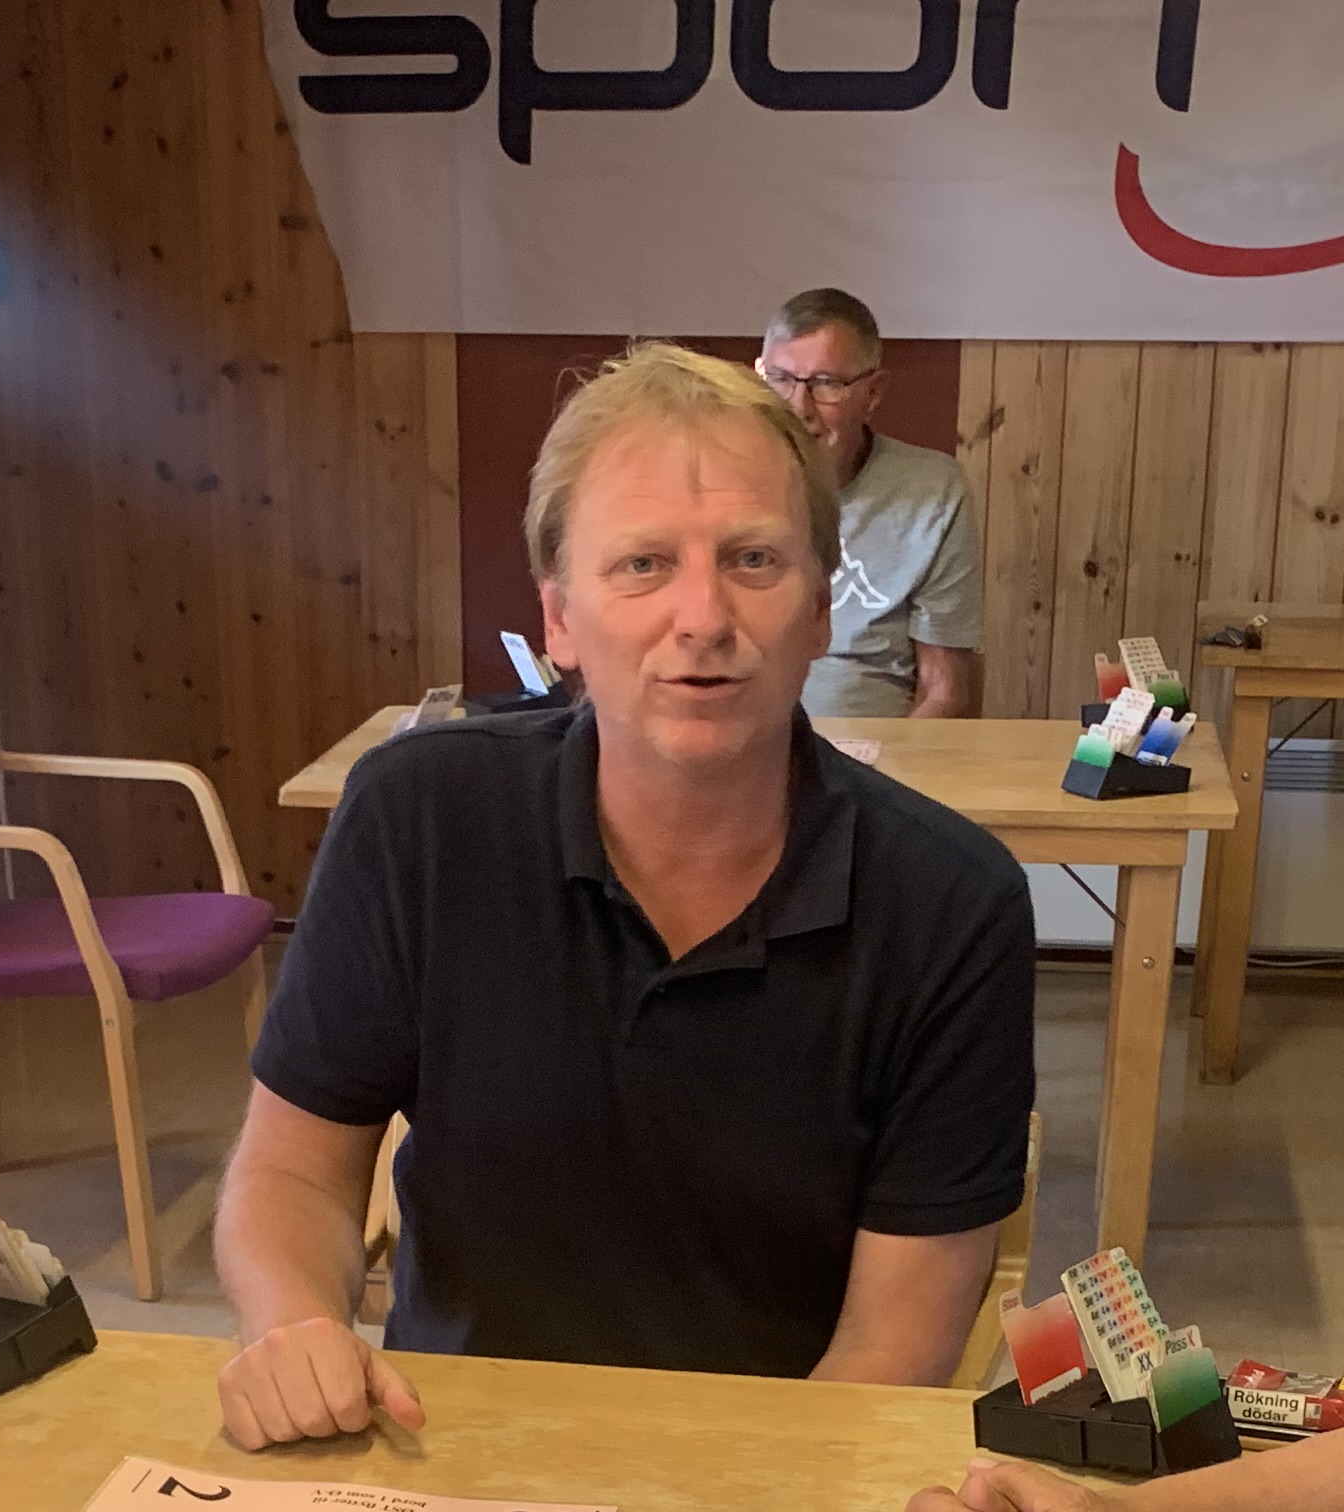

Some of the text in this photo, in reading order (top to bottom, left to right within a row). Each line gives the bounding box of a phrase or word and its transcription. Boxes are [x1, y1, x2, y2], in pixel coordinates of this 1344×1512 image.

[1136, 1350, 1154, 1375] XX
[1233, 1389, 1299, 1412] Rökning
[1242, 1406, 1288, 1422] dödar
[157, 1476, 231, 1502] 2
